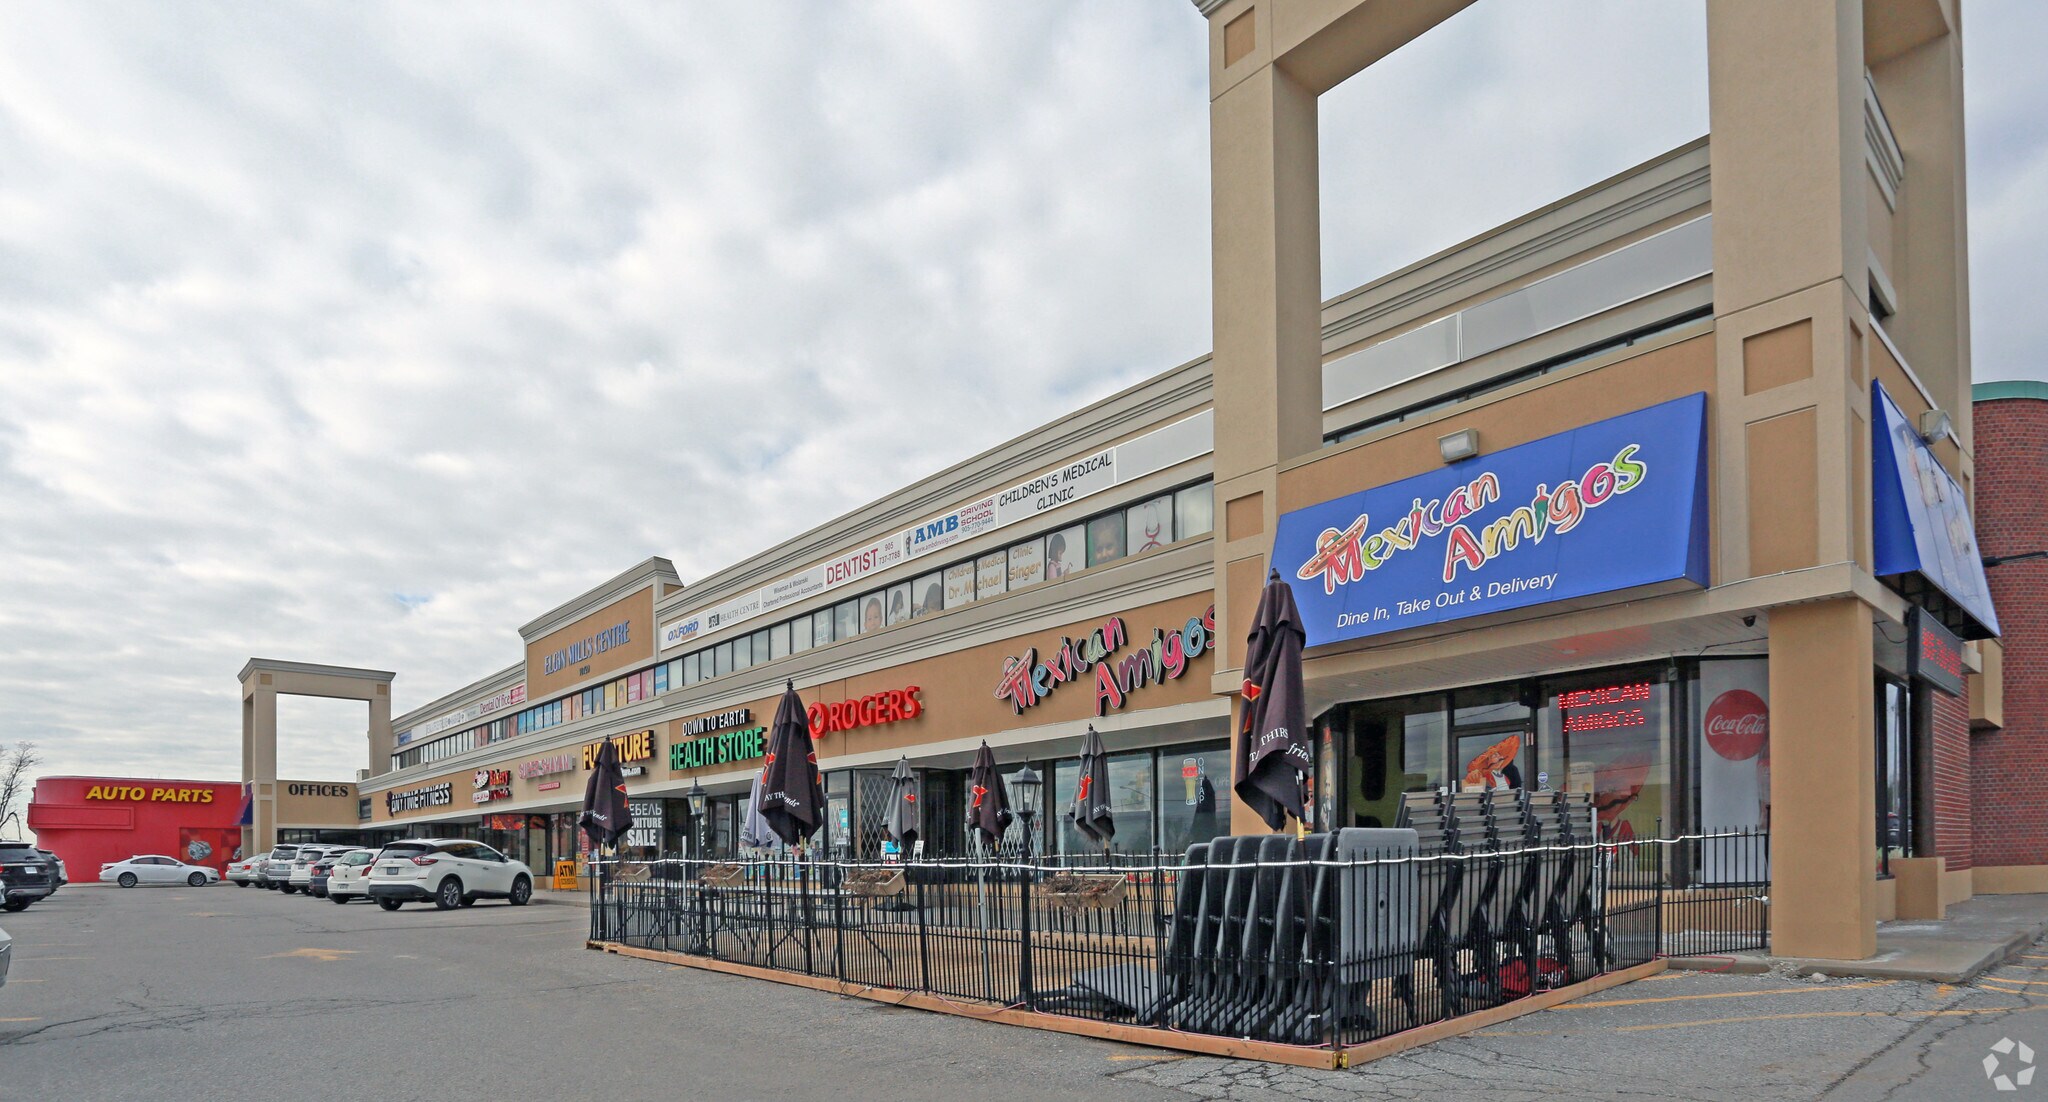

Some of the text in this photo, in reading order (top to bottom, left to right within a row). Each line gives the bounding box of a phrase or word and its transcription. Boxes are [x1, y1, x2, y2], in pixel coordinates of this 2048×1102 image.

[999, 453, 1112, 507] CHILDREN'S MEDICAL
[961, 500, 993, 517] DRIVING
[1037, 486, 1074, 510] CLINIC
[961, 509, 994, 526] SCHOOL
[1442, 443, 1647, 583] Amigos
[914, 515, 959, 545] AMB
[1310, 471, 1500, 595] Mexican
[884, 541, 894, 552] 905
[914, 534, 958, 554] www.ambdriving.com
[1013, 545, 1033, 560] Clinic
[826, 548, 879, 585] DENTIST
[964, 570, 1002, 596] Mchael
[1008, 560, 1042, 581] Singer
[801, 582, 823, 596] Accountants
[1336, 572, 1558, 628] Dine In, Take Out & Delivery
[720, 606, 739, 623] HEALTH
[740, 600, 759, 616] CENTRE
[668, 620, 699, 642] OXFORD
[544, 620, 631, 676] ELGIN MILLS CENTRE
[1000, 616, 1127, 715] Mexican
[480, 698, 495, 714] Dental
[1558, 683, 1649, 709] MEXICAN
[829, 686, 921, 732] ROGERS
[1563, 709, 1645, 732] AMIGOS
[682, 709, 746, 736] DOWN TO EARTH
[1708, 714, 1767, 736] Coca-Cola
[670, 726, 764, 770] HEALTH STORE
[1260, 727, 1289, 747] THIRS
[86, 785, 213, 803] AUTO PARTS
[288, 783, 349, 797] OFFICES
[391, 787, 419, 813] ANYTIME
[419, 782, 451, 808] FITNESS
[627, 829, 657, 847] SALE
[559, 864, 575, 877] ATM
